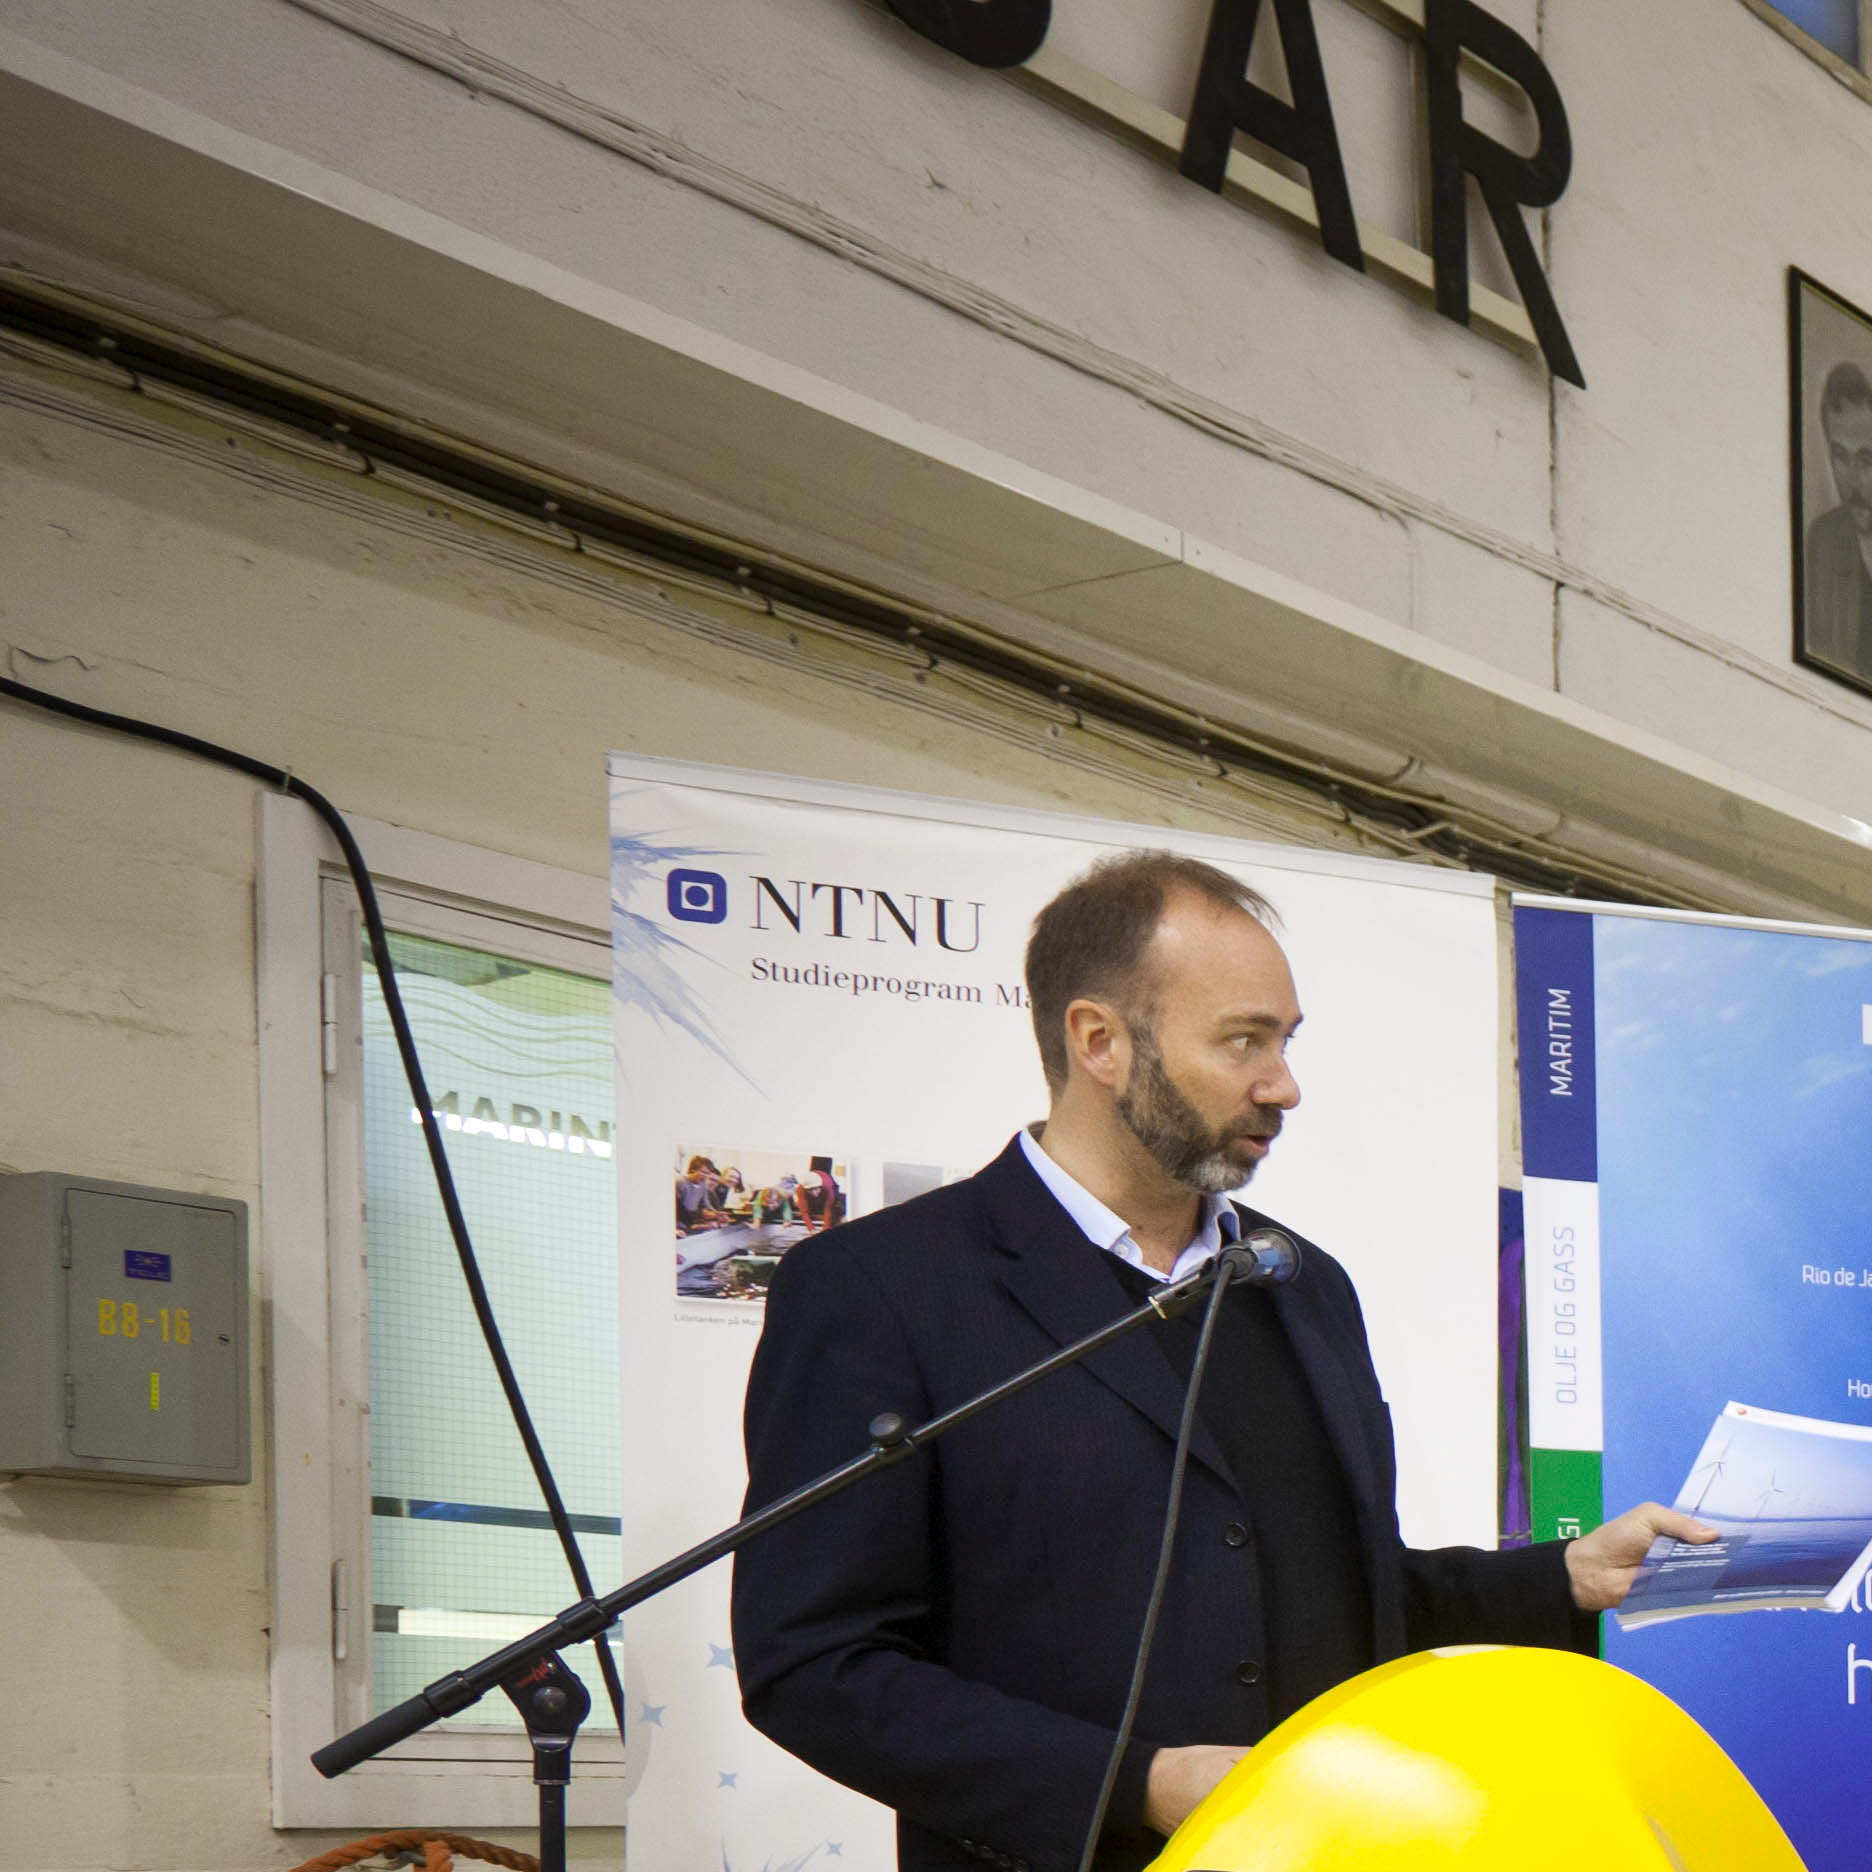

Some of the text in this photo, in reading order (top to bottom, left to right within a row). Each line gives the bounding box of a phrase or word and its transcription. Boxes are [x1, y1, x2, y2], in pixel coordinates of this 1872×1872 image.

[886, 0, 1586, 390] AR
[749, 874, 986, 953] NTNU
[750, 957, 1034, 1010] Studieprogram Ma
[1549, 988, 1572, 1098] MARITIM
[411, 1090, 617, 1160] MARIN
[1552, 1225, 1578, 1404] OLJE OG GASS
[1802, 1265, 1830, 1286] Rio
[1834, 1266, 1856, 1287] de
